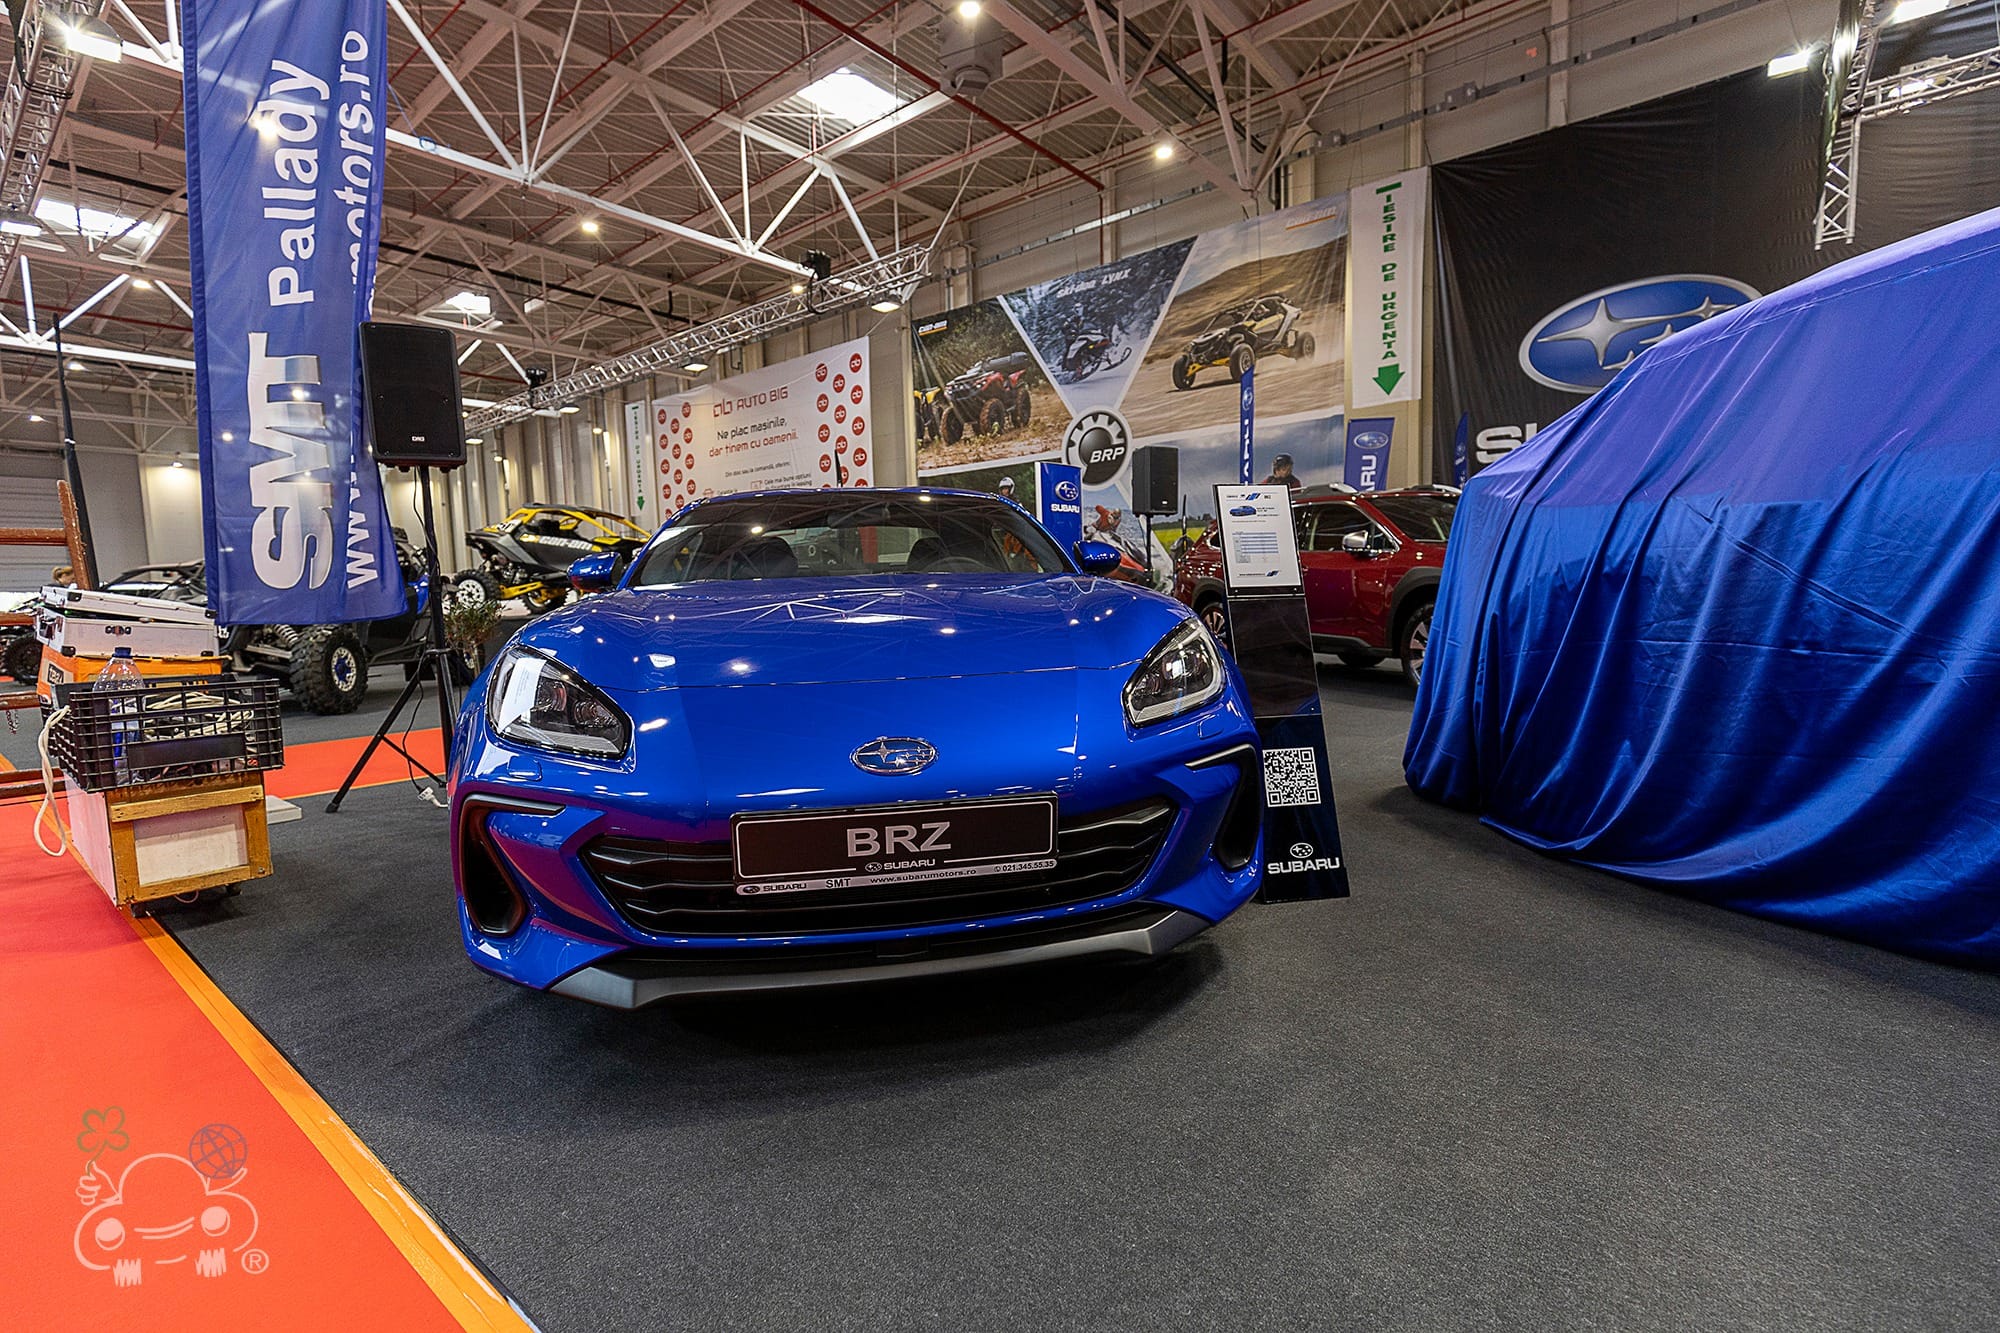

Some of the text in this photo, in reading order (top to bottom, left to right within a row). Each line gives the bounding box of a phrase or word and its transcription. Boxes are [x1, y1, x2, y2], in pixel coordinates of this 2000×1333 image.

[1101, 268, 1132, 285] LYNX
[1380, 194, 1398, 360] IESIRE DE URGENTA
[247, 59, 333, 590] SMT Pallady
[737, 393, 767, 410] AUTO
[769, 386, 788, 402] BIG
[717, 430, 728, 440] Ne
[731, 426, 748, 439] plac
[709, 446, 723, 457] dar
[750, 440, 761, 449] cu
[1090, 447, 1124, 463] BRP
[1051, 503, 1081, 513] SUBARU
[846, 821, 952, 857] BRZ
[884, 859, 935, 870] SUBARU
[1267, 857, 1340, 874] SUBARU
[763, 860, 1054, 892] SUBARU SMT www.subarumotors.ro 021.345.55.35
